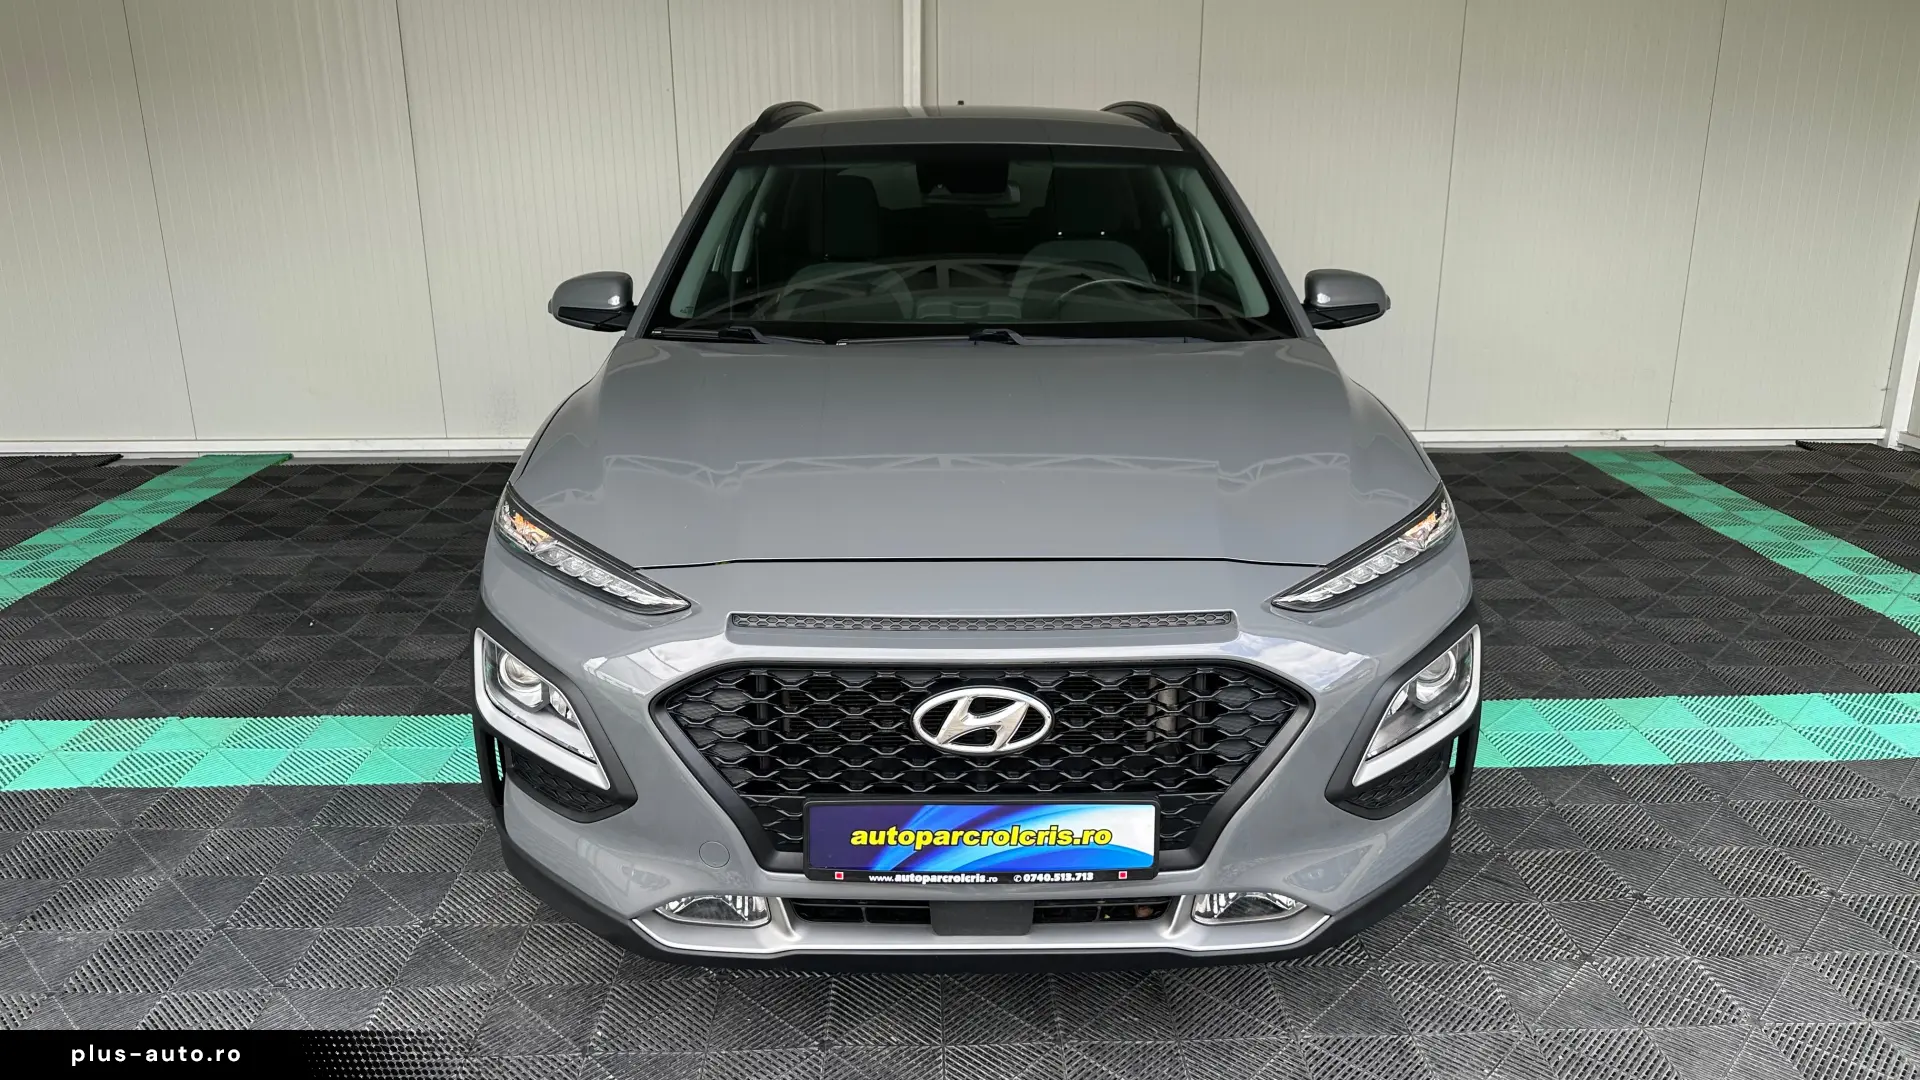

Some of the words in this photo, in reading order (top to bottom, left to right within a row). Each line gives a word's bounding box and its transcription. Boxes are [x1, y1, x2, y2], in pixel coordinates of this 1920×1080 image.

[850, 825, 1113, 850] autoparcrolcris.ro
[868, 873, 998, 884] www.autoparcrolcris.ro
[1023, 872, 1094, 883] 0740.513.713
